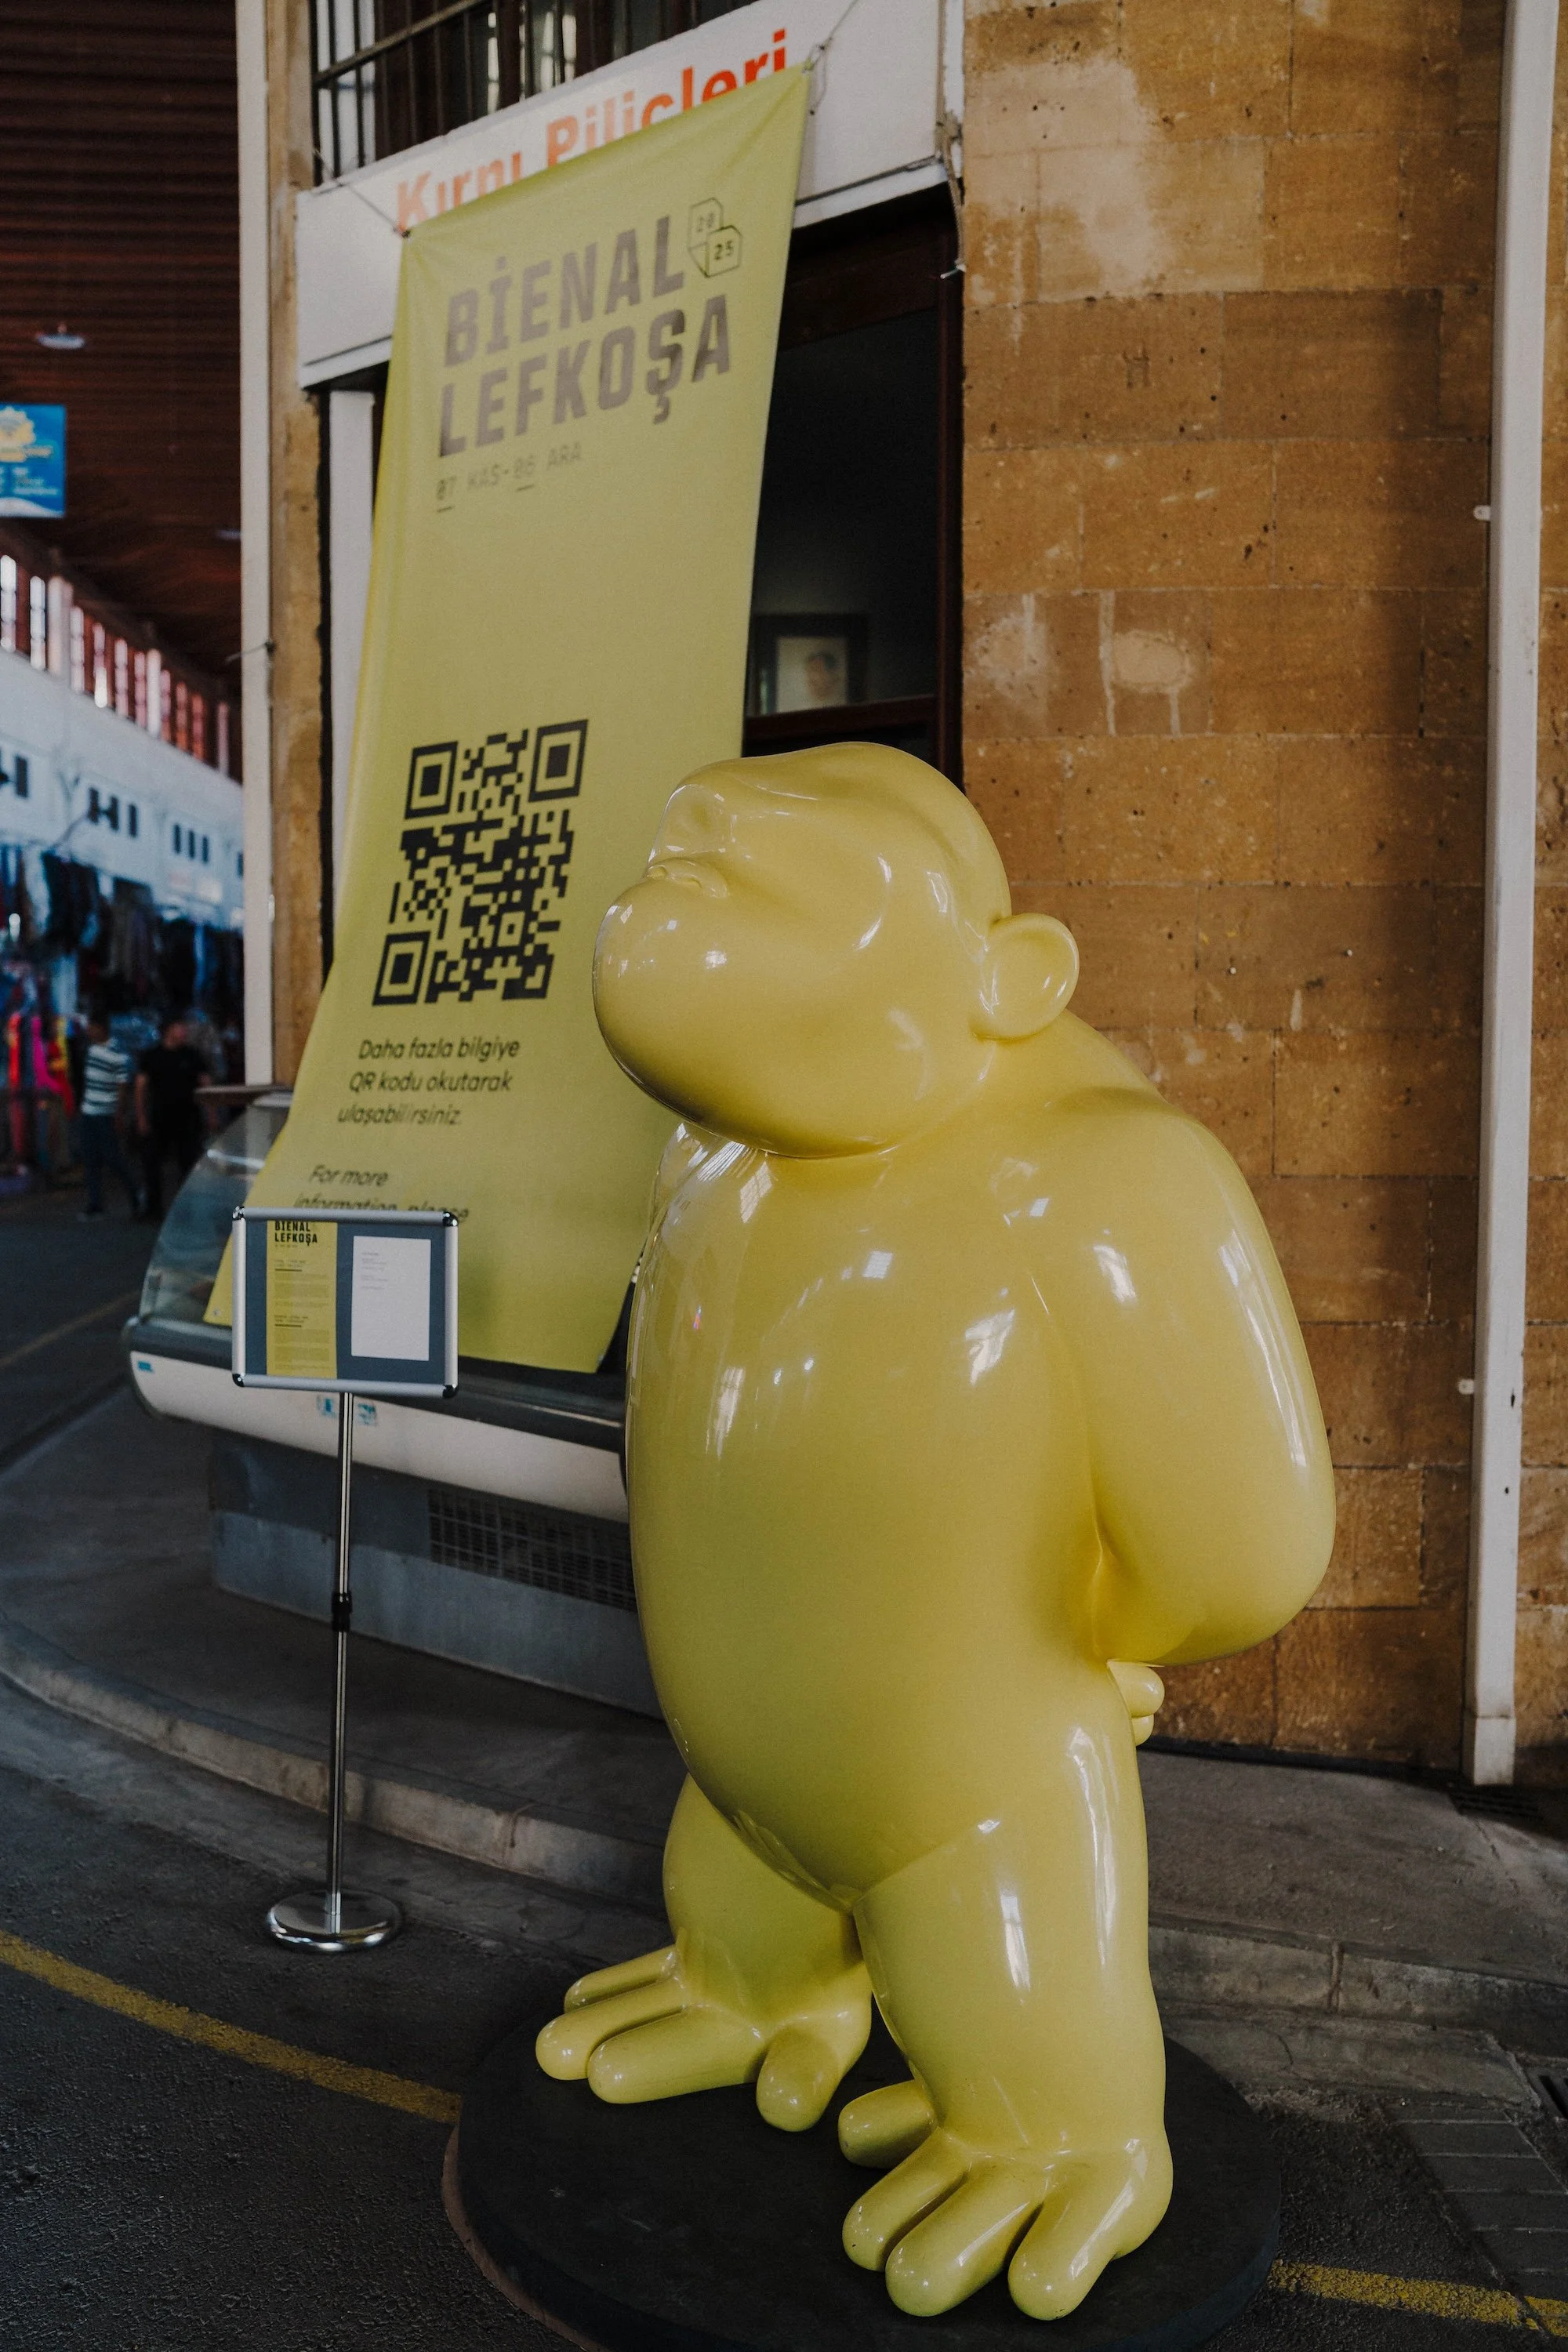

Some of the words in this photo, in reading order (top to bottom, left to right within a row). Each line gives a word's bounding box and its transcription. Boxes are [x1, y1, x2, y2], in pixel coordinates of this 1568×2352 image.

[714, 240, 734, 260] 25
[445, 216, 685, 367] BİENAL
[439, 295, 731, 458] LEFKOŞA
[358, 1039, 405, 1059] Daha
[408, 1037, 454, 1059] fazla
[457, 1036, 521, 1062] bilgiye
[349, 1071, 376, 1093] QR
[377, 1071, 420, 1092] kodu
[426, 1070, 513, 1092] okutarak
[309, 1164, 339, 1183] For
[340, 1169, 389, 1187] more
[274, 1232, 318, 1246] LEFKOŞA
